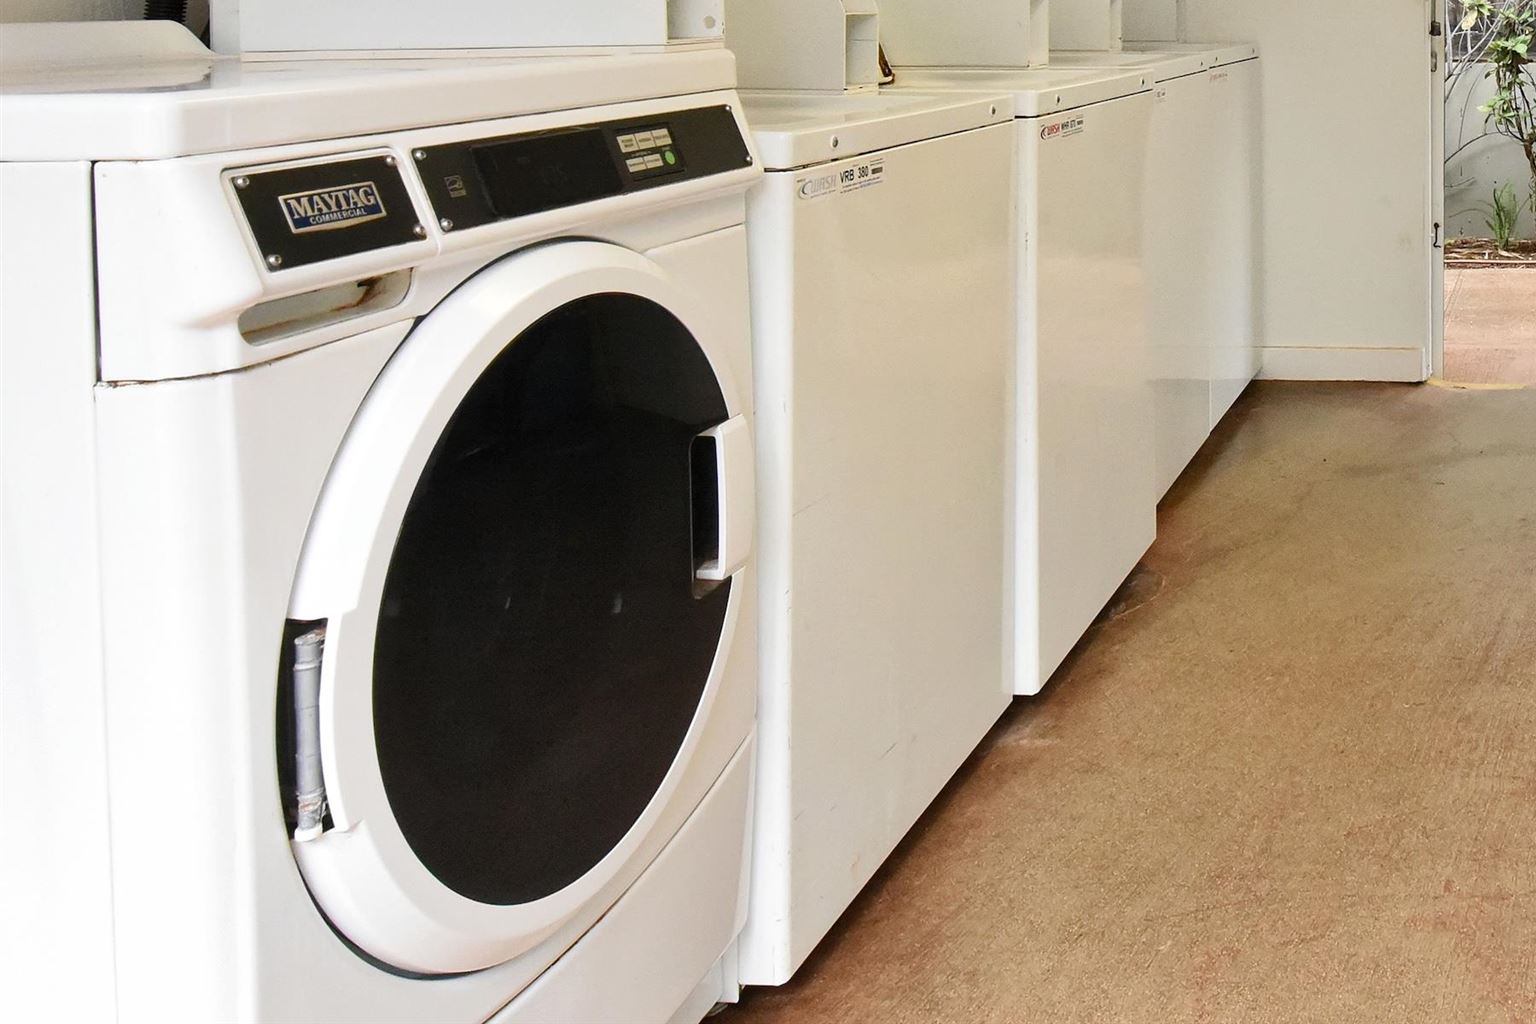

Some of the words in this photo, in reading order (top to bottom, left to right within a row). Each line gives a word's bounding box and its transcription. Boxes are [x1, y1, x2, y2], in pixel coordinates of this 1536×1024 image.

[839, 169, 855, 184] VRB
[857, 165, 869, 179] 380
[287, 187, 376, 219] MAYTAG
[309, 207, 368, 225] COMMERCIAL
